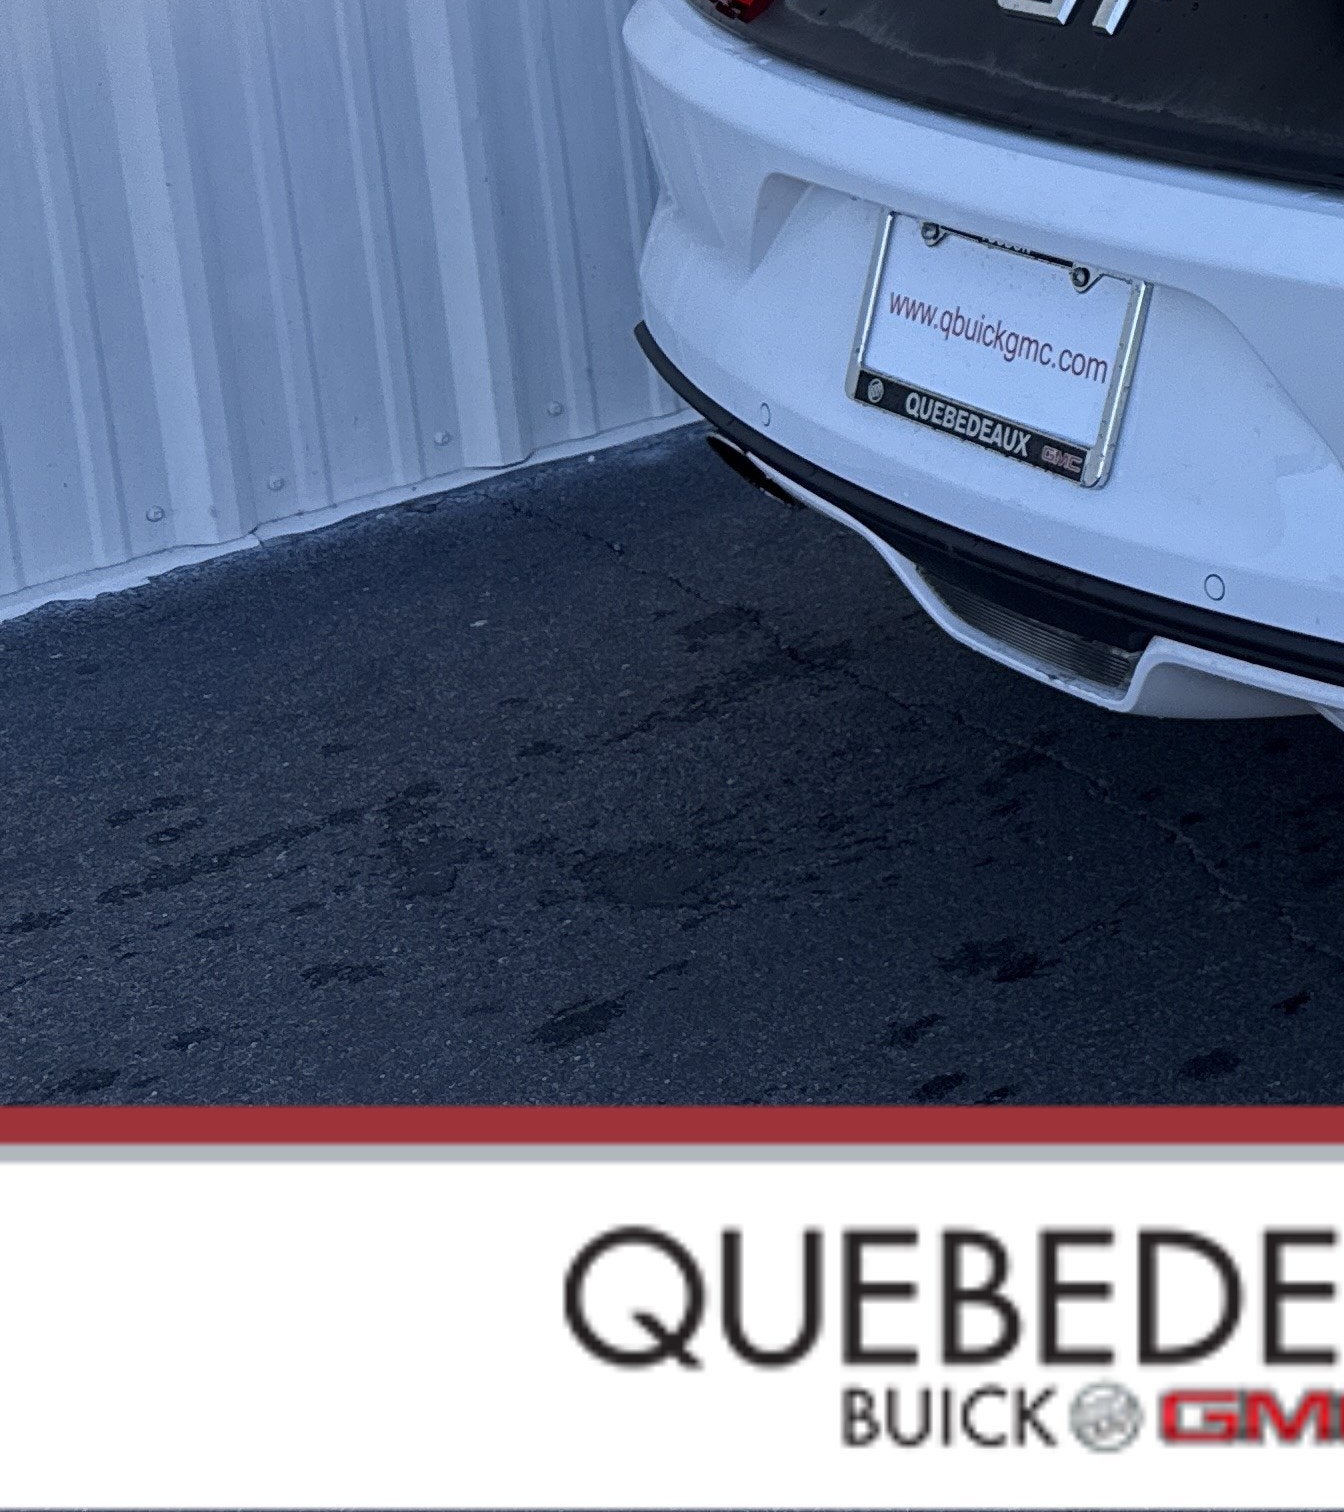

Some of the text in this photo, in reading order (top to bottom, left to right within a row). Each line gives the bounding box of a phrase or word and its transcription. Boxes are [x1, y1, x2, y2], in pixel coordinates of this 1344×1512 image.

[889, 291, 1108, 384] www.qbuickgmc.com
[904, 391, 1084, 473] QUEBEDEAUX GMC
